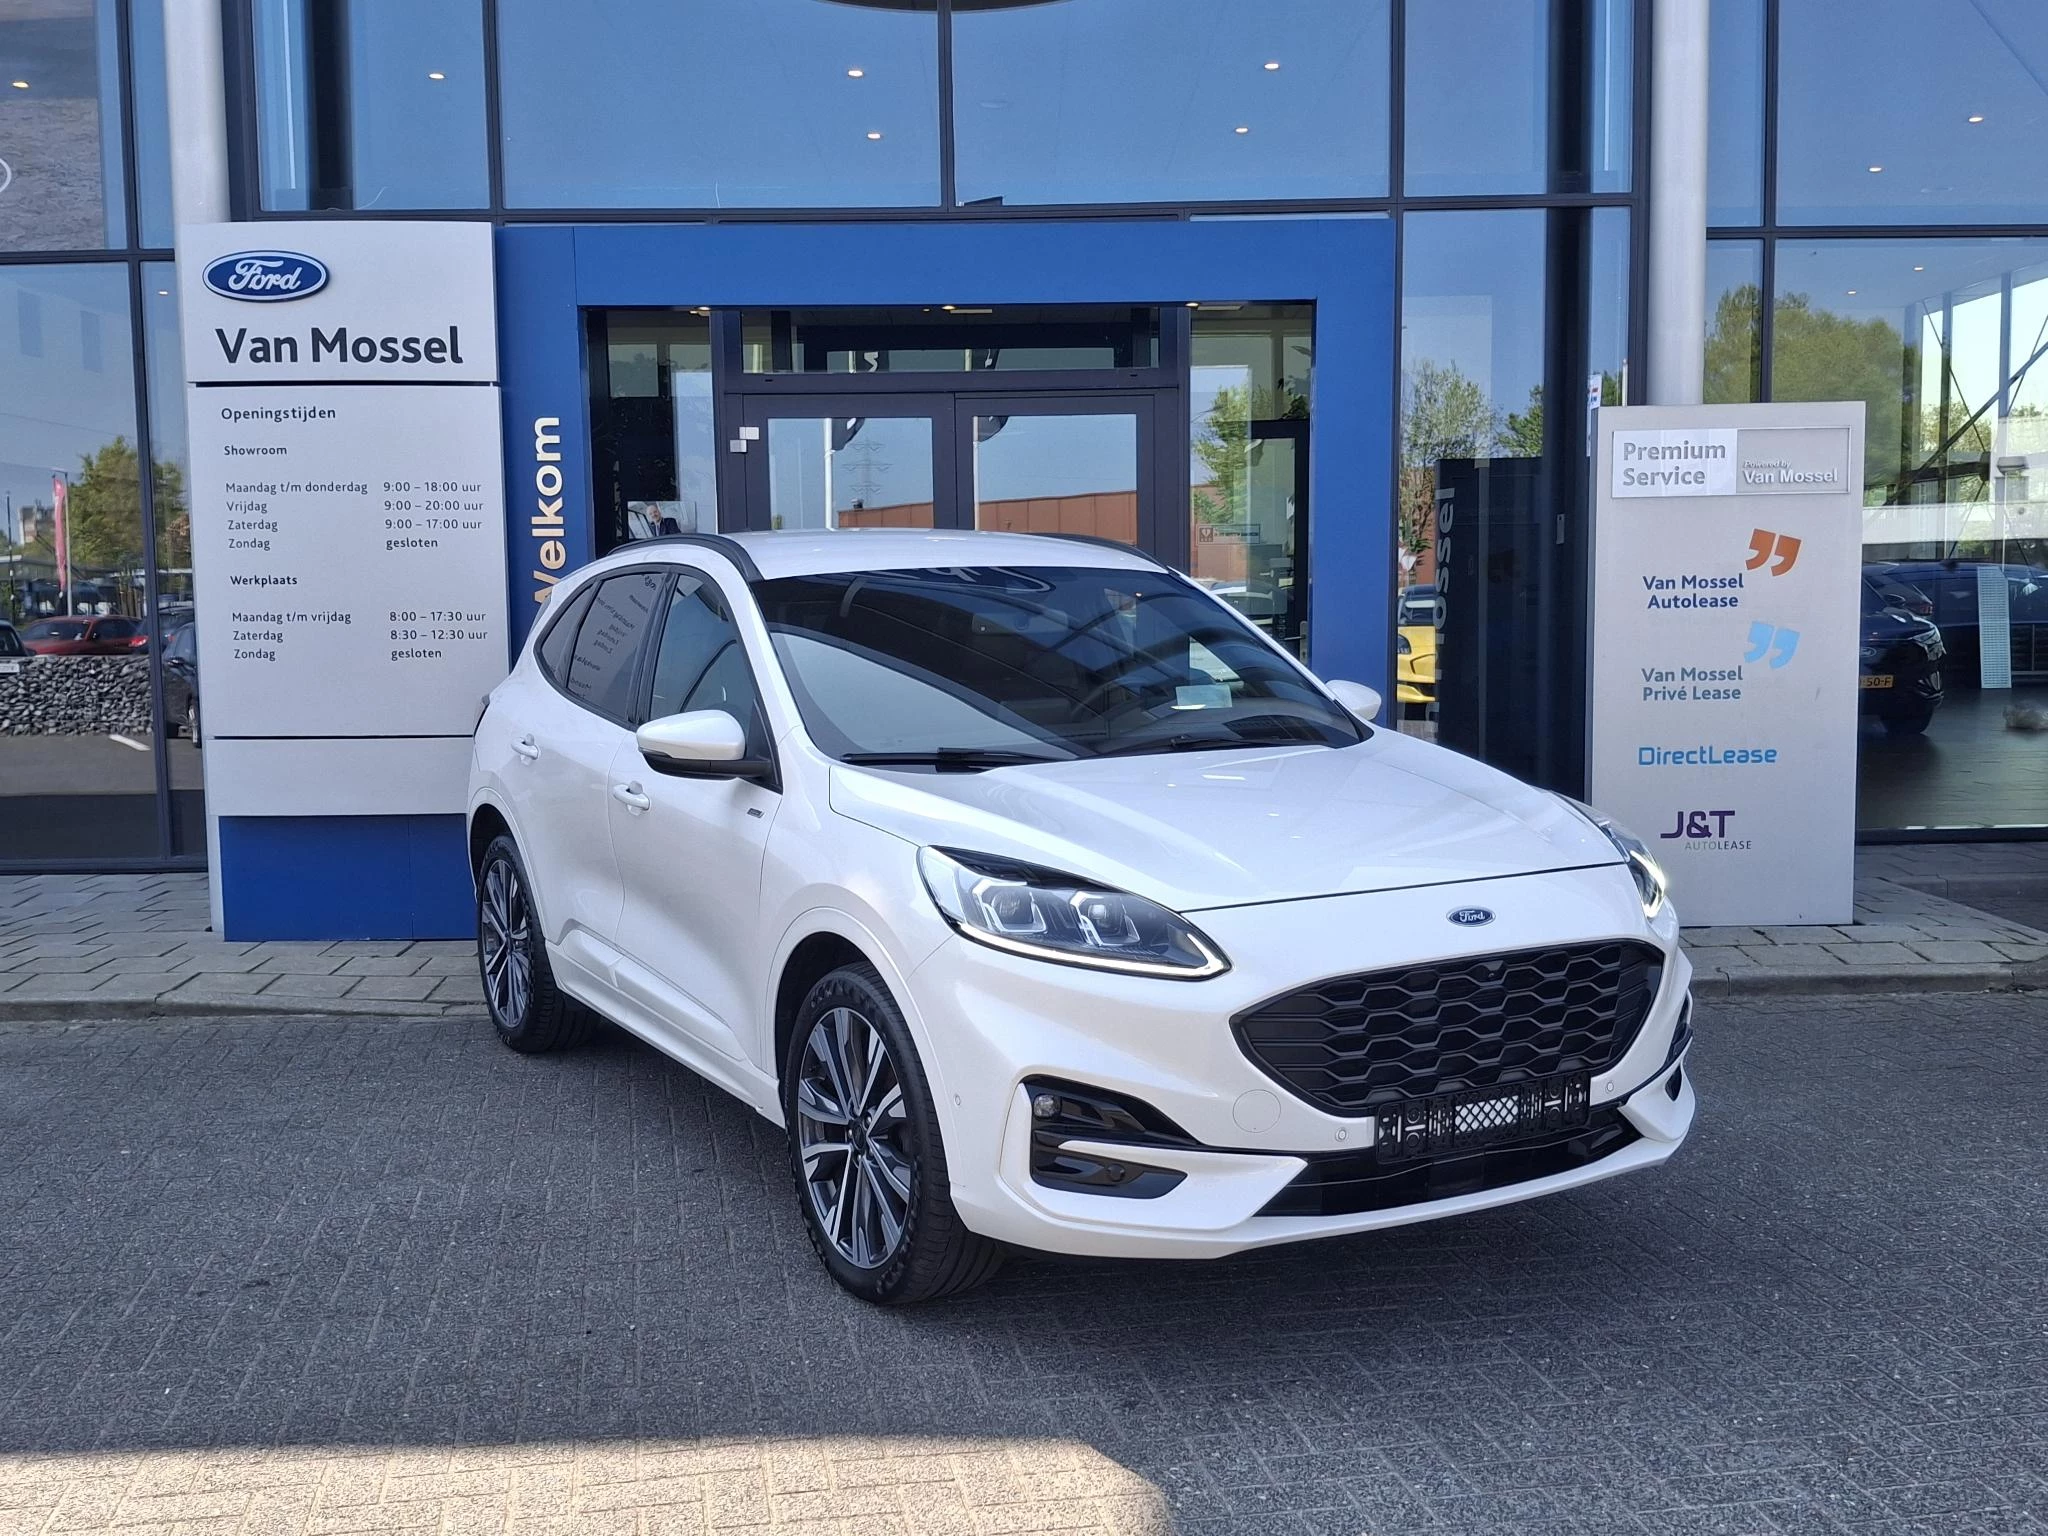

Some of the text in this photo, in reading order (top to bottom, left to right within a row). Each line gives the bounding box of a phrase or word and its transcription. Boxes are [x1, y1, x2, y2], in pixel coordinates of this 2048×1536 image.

[228, 259, 302, 290] Ford
[215, 326, 463, 364] Van Mossel
[221, 406, 336, 423] Openingstijden
[224, 445, 288, 456] Showroom
[1623, 440, 1726, 464] Premium
[1744, 460, 1791, 469] Powered by
[1623, 466, 1706, 486] Service
[1743, 467, 1838, 484] Van Mossel
[225, 482, 277, 495] Maandag
[280, 482, 301, 493] t/m
[305, 481, 369, 495] donderdag
[383, 481, 411, 493] 9:00
[425, 481, 458, 492] 18:00
[462, 484, 482, 493] uur
[226, 501, 268, 514] Vrijdag
[384, 500, 412, 511] 9:00
[425, 500, 460, 511] 20:00
[464, 502, 484, 511] uur
[228, 519, 279, 532] Zaterdag
[385, 519, 413, 530] 9:00
[426, 518, 459, 530] 17:00
[462, 521, 483, 530] uur
[228, 537, 438, 551] Zondag gesloten
[230, 575, 298, 588] Werkplaats
[1643, 573, 1745, 590] Van Mossel
[1647, 593, 1739, 609] Autolease
[232, 612, 283, 625] Maandag
[286, 612, 308, 623] t/m
[311, 611, 352, 625] vrijdag
[389, 611, 417, 622] 8:00
[430, 611, 463, 622] 17:30
[466, 614, 487, 622] uur
[233, 630, 284, 643] Zaterdag
[390, 629, 418, 640] 8:30
[431, 628, 465, 640] 12:30
[468, 632, 488, 640] uur
[234, 648, 442, 662] Zondag gesloten
[1641, 665, 1743, 682] Van Mossel
[1642, 685, 1741, 701] Privé Lease
[1638, 746, 1778, 765] DirectLease
[1660, 810, 1736, 838] J&T
[1685, 840, 1752, 850] AUTOLEASE
[1459, 910, 1486, 922] Ford
